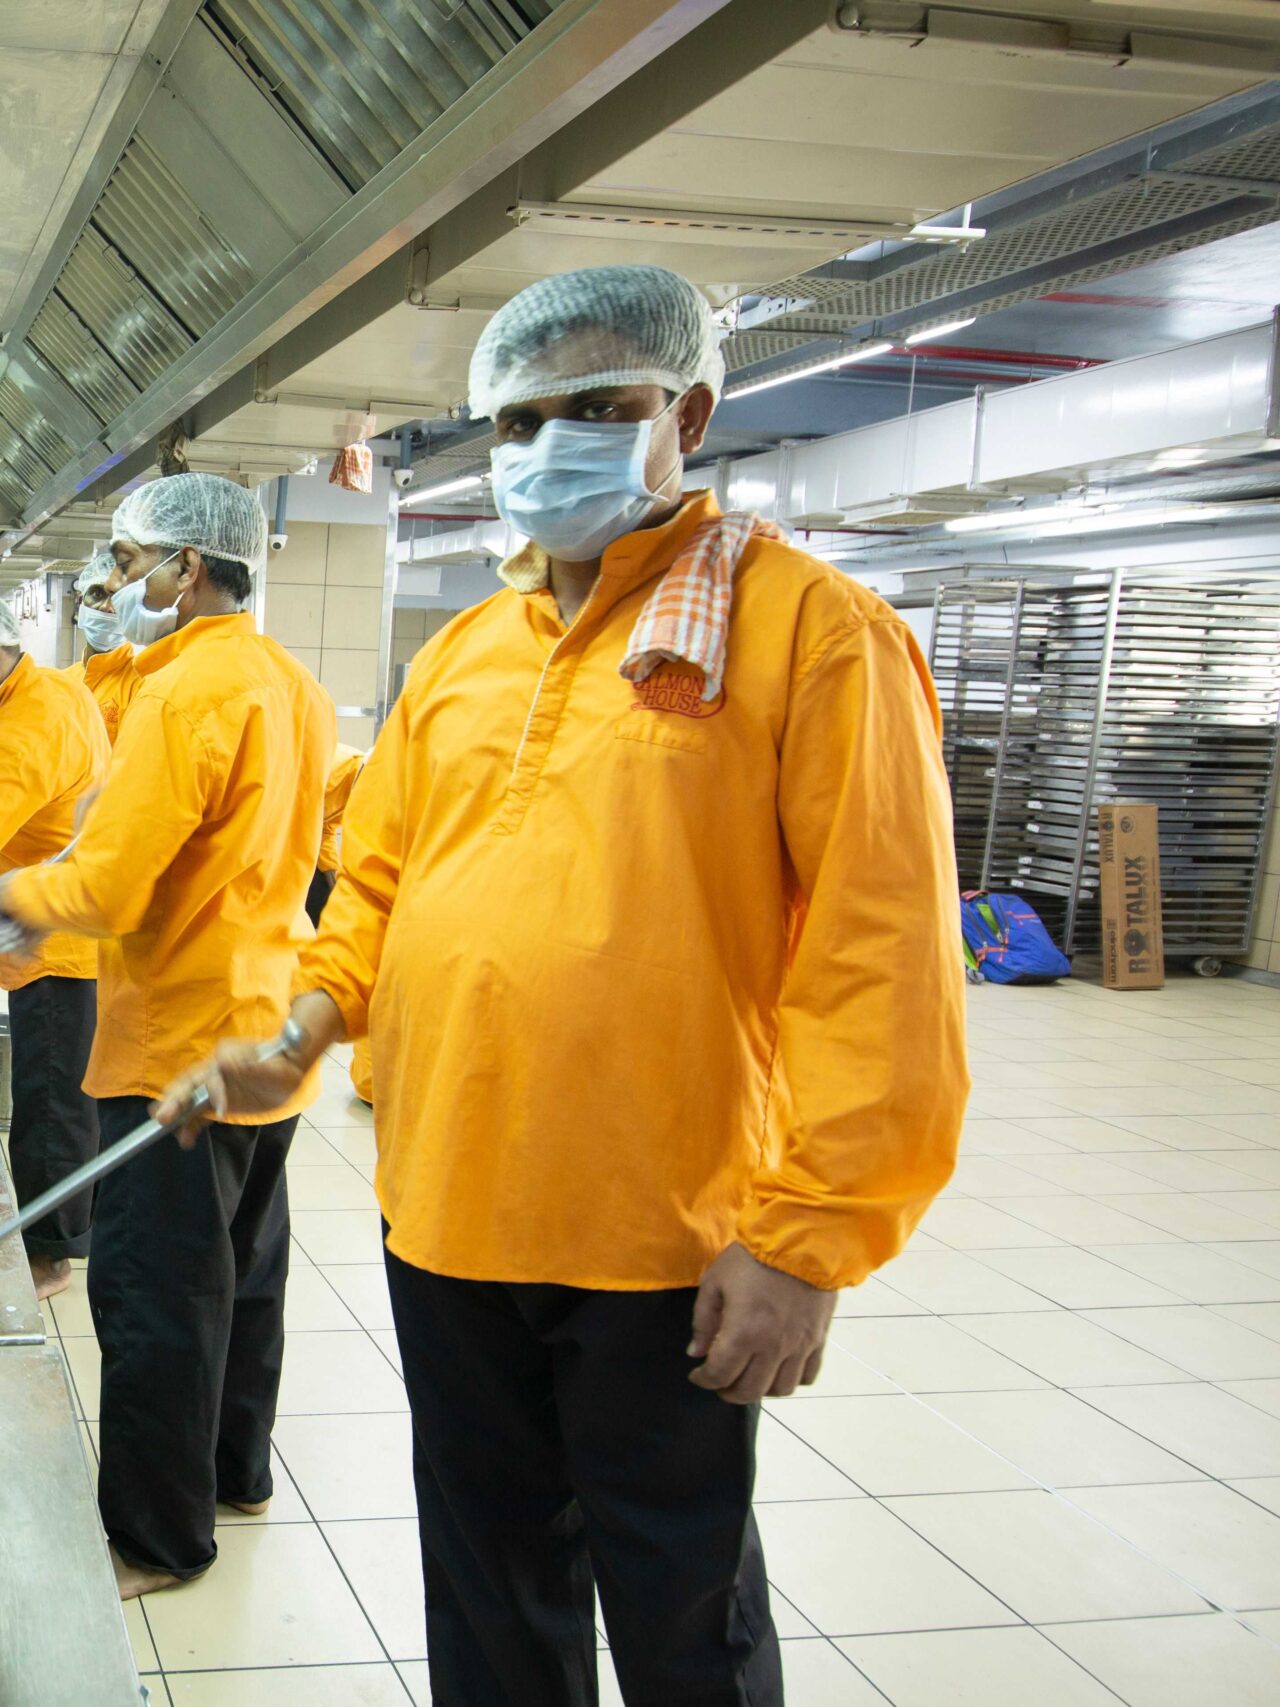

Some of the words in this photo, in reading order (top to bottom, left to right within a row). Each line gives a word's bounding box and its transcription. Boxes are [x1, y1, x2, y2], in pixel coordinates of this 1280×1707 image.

[640, 671, 705, 694] ALMON
[643, 690, 701, 713] HOUSE
[1123, 856, 1148, 973] ROTALUX
